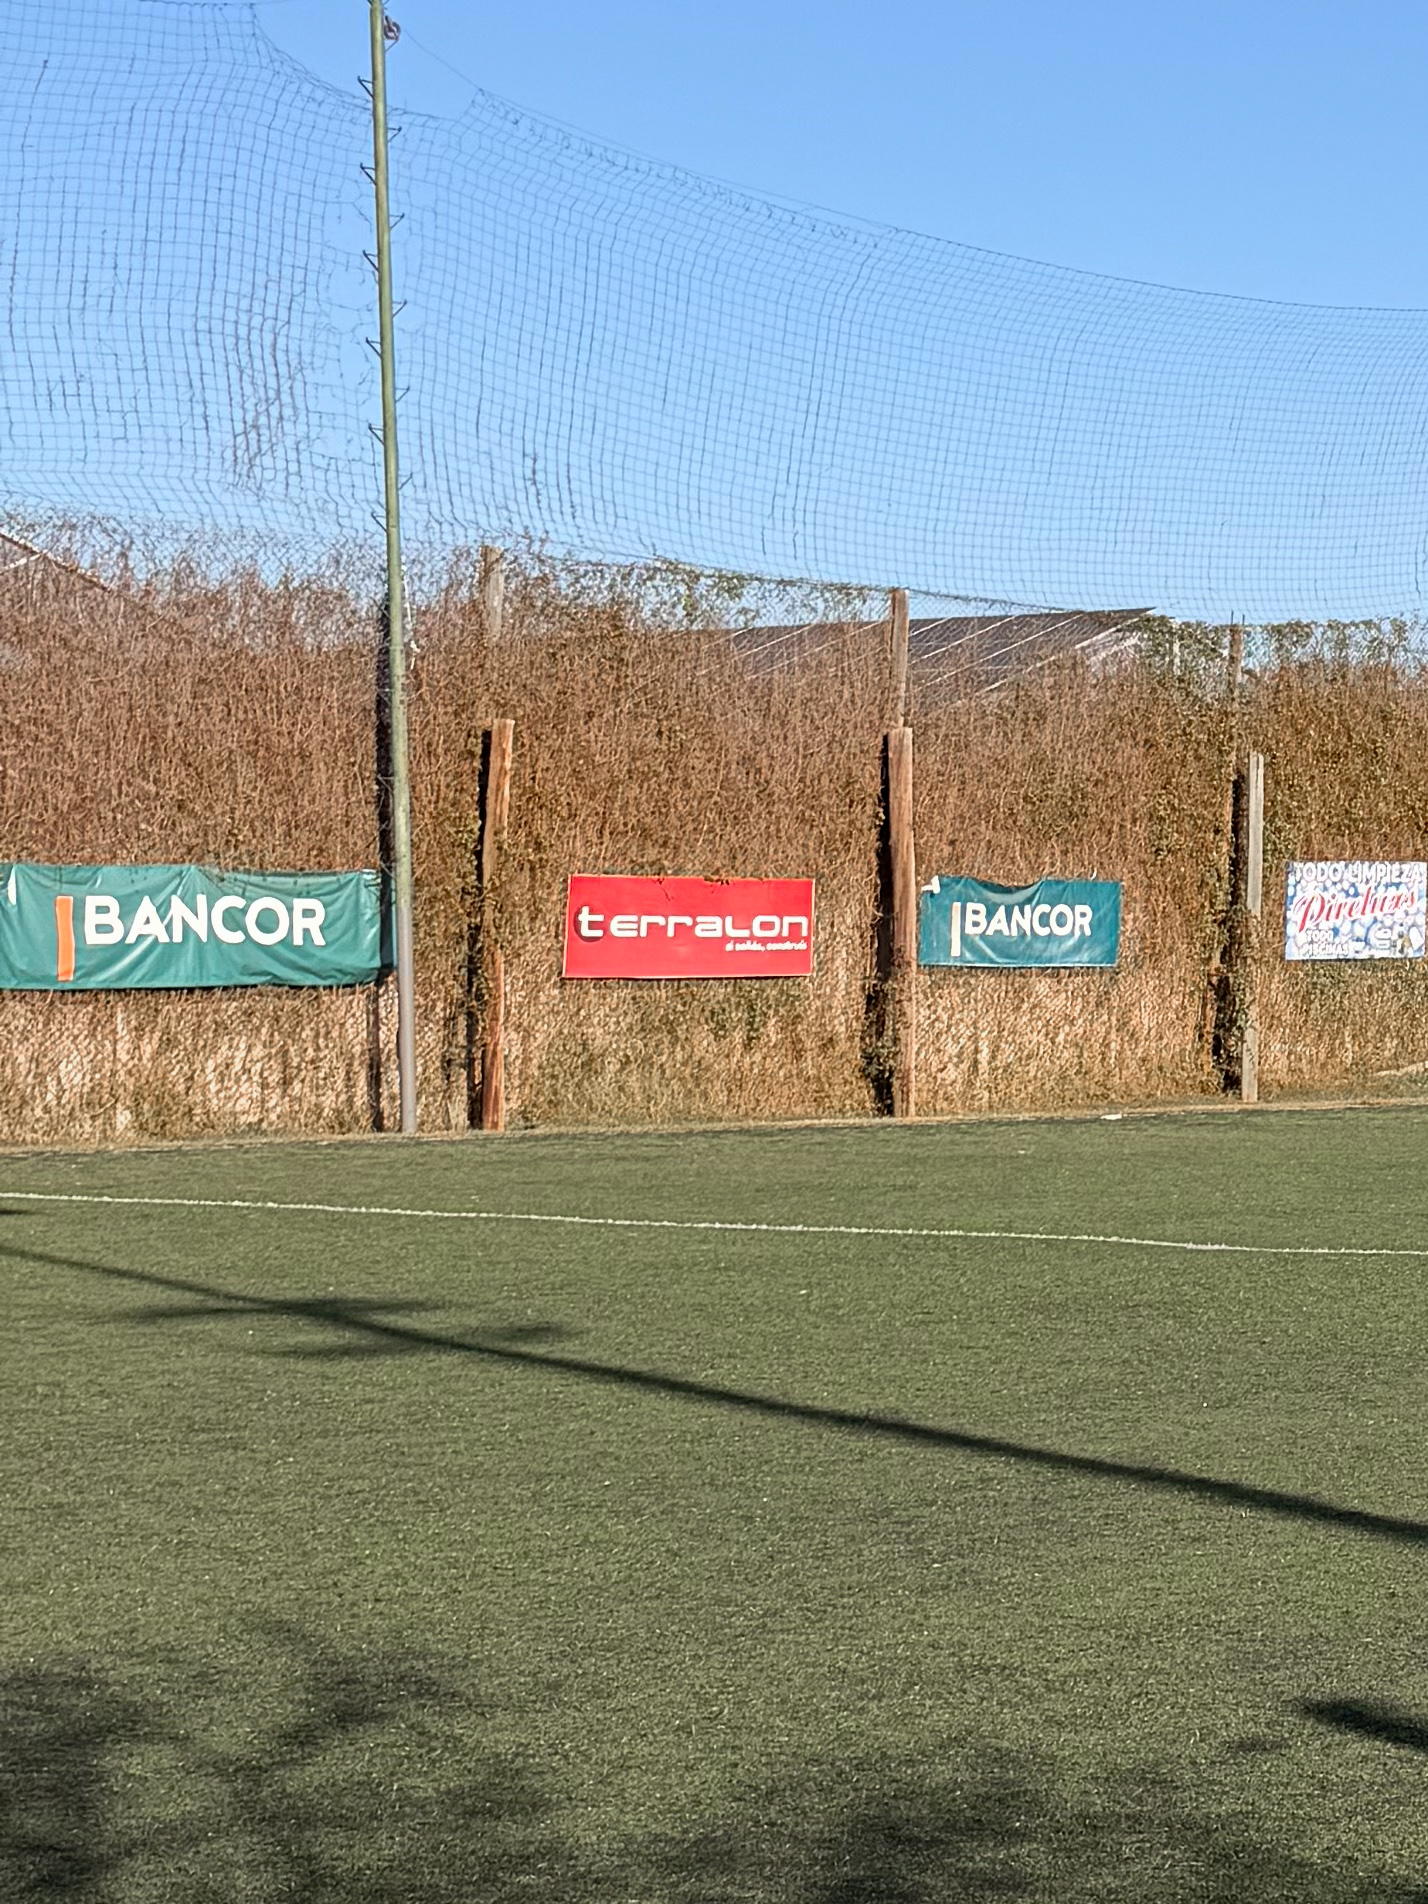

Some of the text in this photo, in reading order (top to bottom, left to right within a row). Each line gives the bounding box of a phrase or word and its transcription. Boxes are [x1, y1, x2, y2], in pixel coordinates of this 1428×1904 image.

[1293, 861, 1422, 883] TODO LIMPIEZA
[84, 894, 326, 946] BANCOR
[965, 902, 1093, 937] BANCOR
